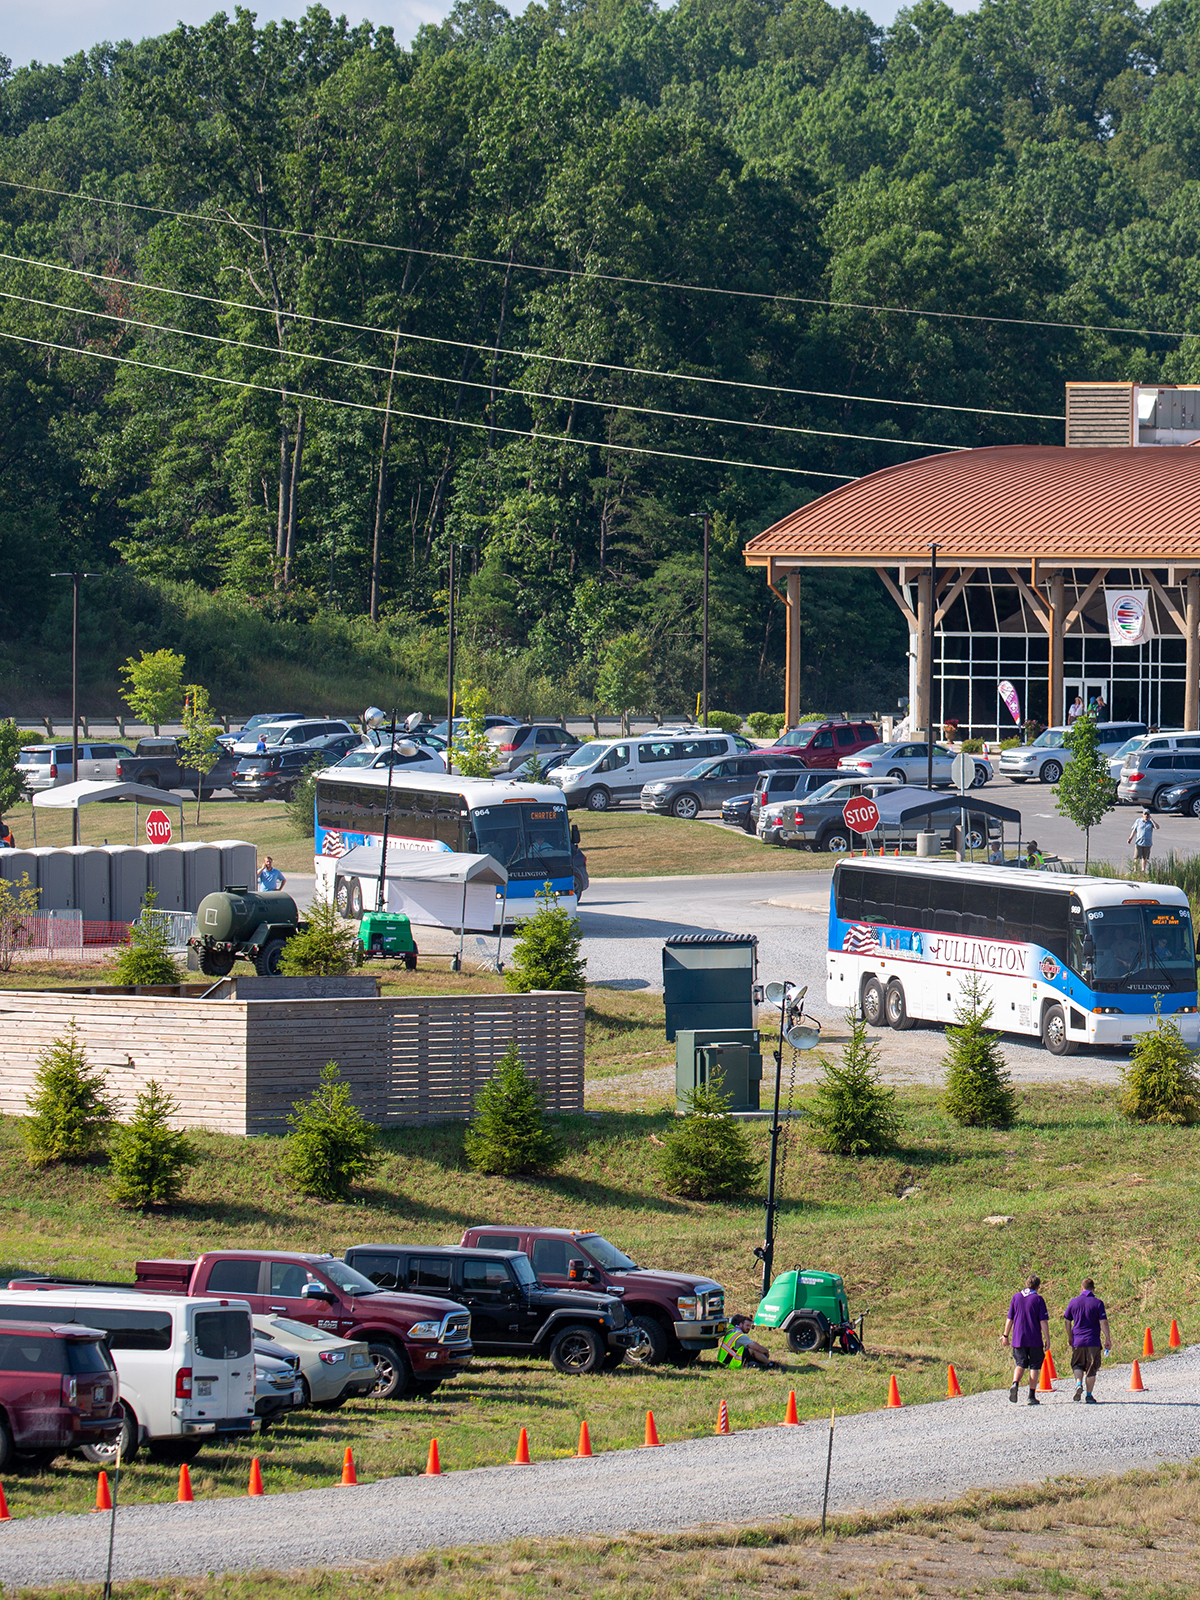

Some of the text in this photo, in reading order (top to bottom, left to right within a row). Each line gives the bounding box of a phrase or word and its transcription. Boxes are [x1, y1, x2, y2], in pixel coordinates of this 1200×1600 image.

[475, 808, 490, 817] 964
[530, 811, 557, 820] CHARTER
[846, 805, 876, 825] STOP
[147, 821, 170, 837] STOP
[508, 870, 548, 878] FULLINGTON
[1088, 911, 1104, 920] 969
[930, 938, 1028, 971] FULLINGTON
